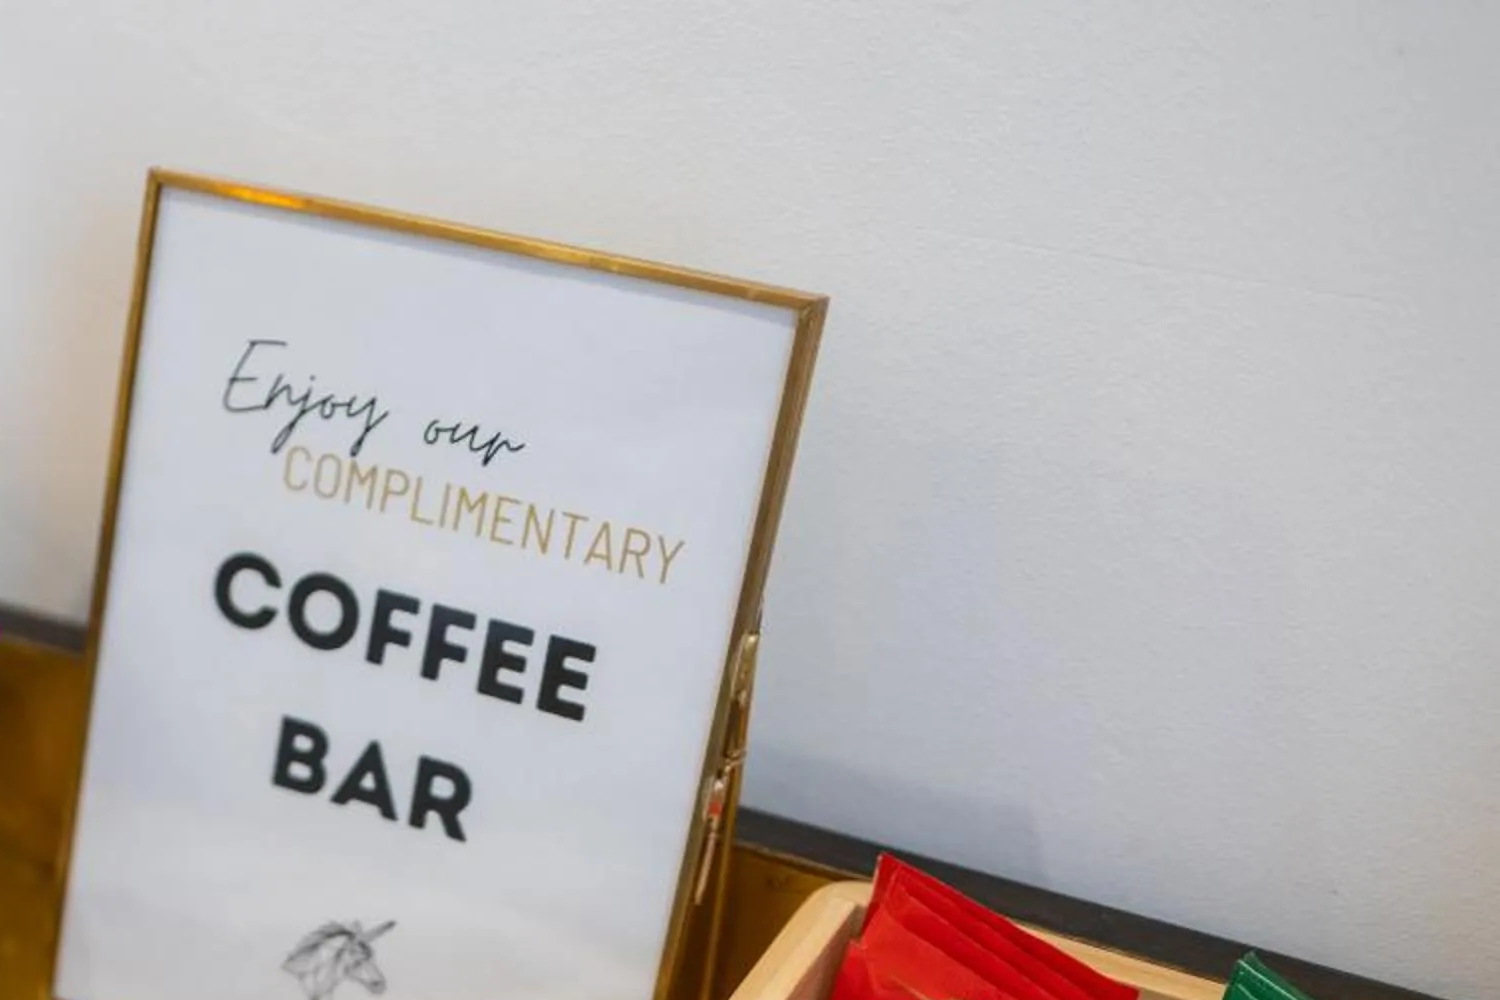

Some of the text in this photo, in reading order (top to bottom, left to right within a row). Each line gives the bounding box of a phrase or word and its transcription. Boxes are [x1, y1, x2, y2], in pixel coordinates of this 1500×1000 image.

[223, 339, 526, 467] Enjoy our
[281, 445, 687, 585] COMPLIMENTARY
[213, 551, 598, 722] COFFEE
[271, 714, 474, 843] BAR
